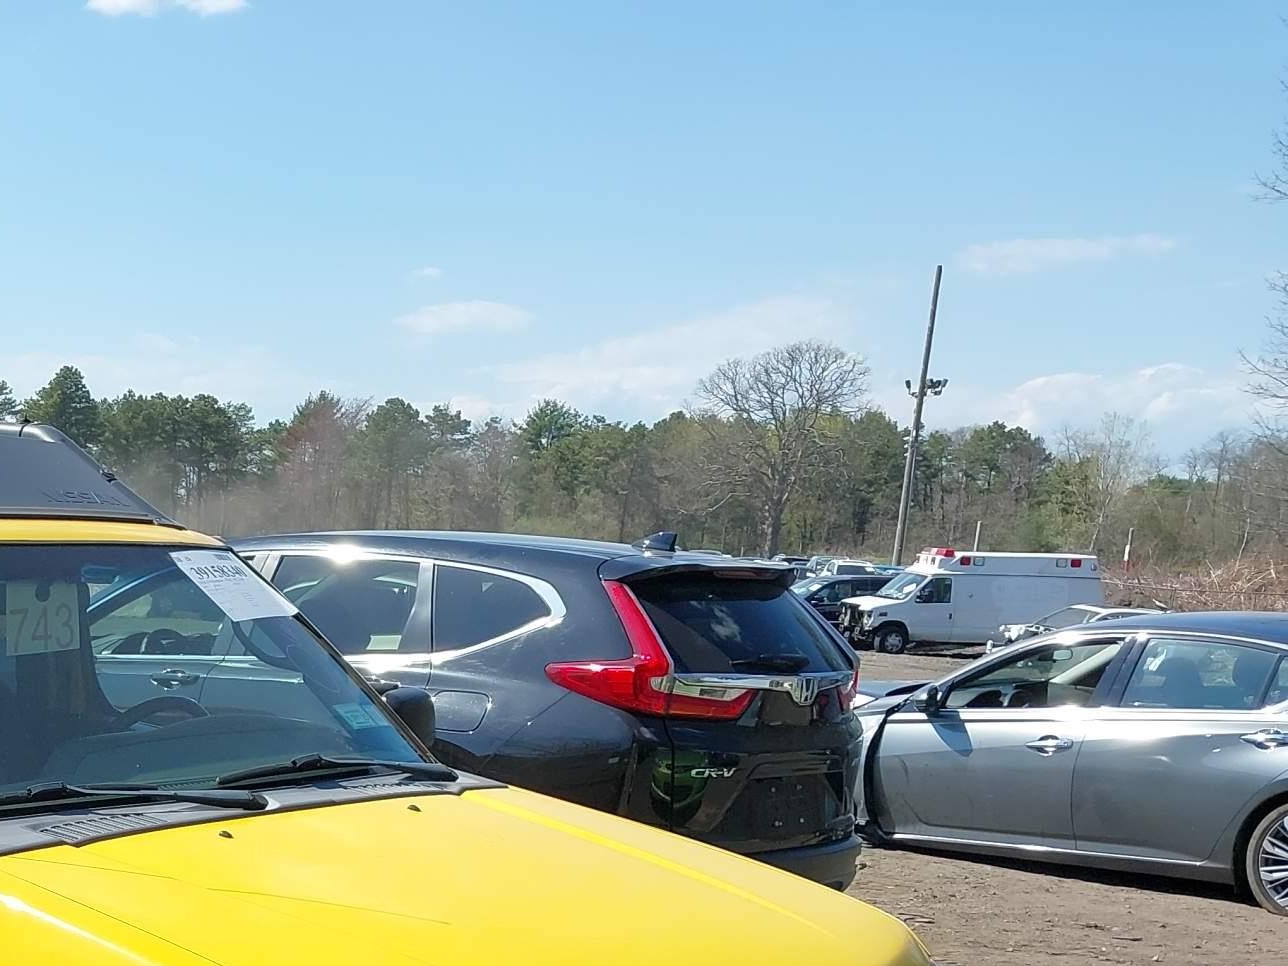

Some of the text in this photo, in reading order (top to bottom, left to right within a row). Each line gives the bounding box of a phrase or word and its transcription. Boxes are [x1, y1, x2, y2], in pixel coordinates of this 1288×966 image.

[190, 564, 249, 581] 39158340
[9, 602, 75, 654] 743
[690, 767, 737, 778] CR-V
